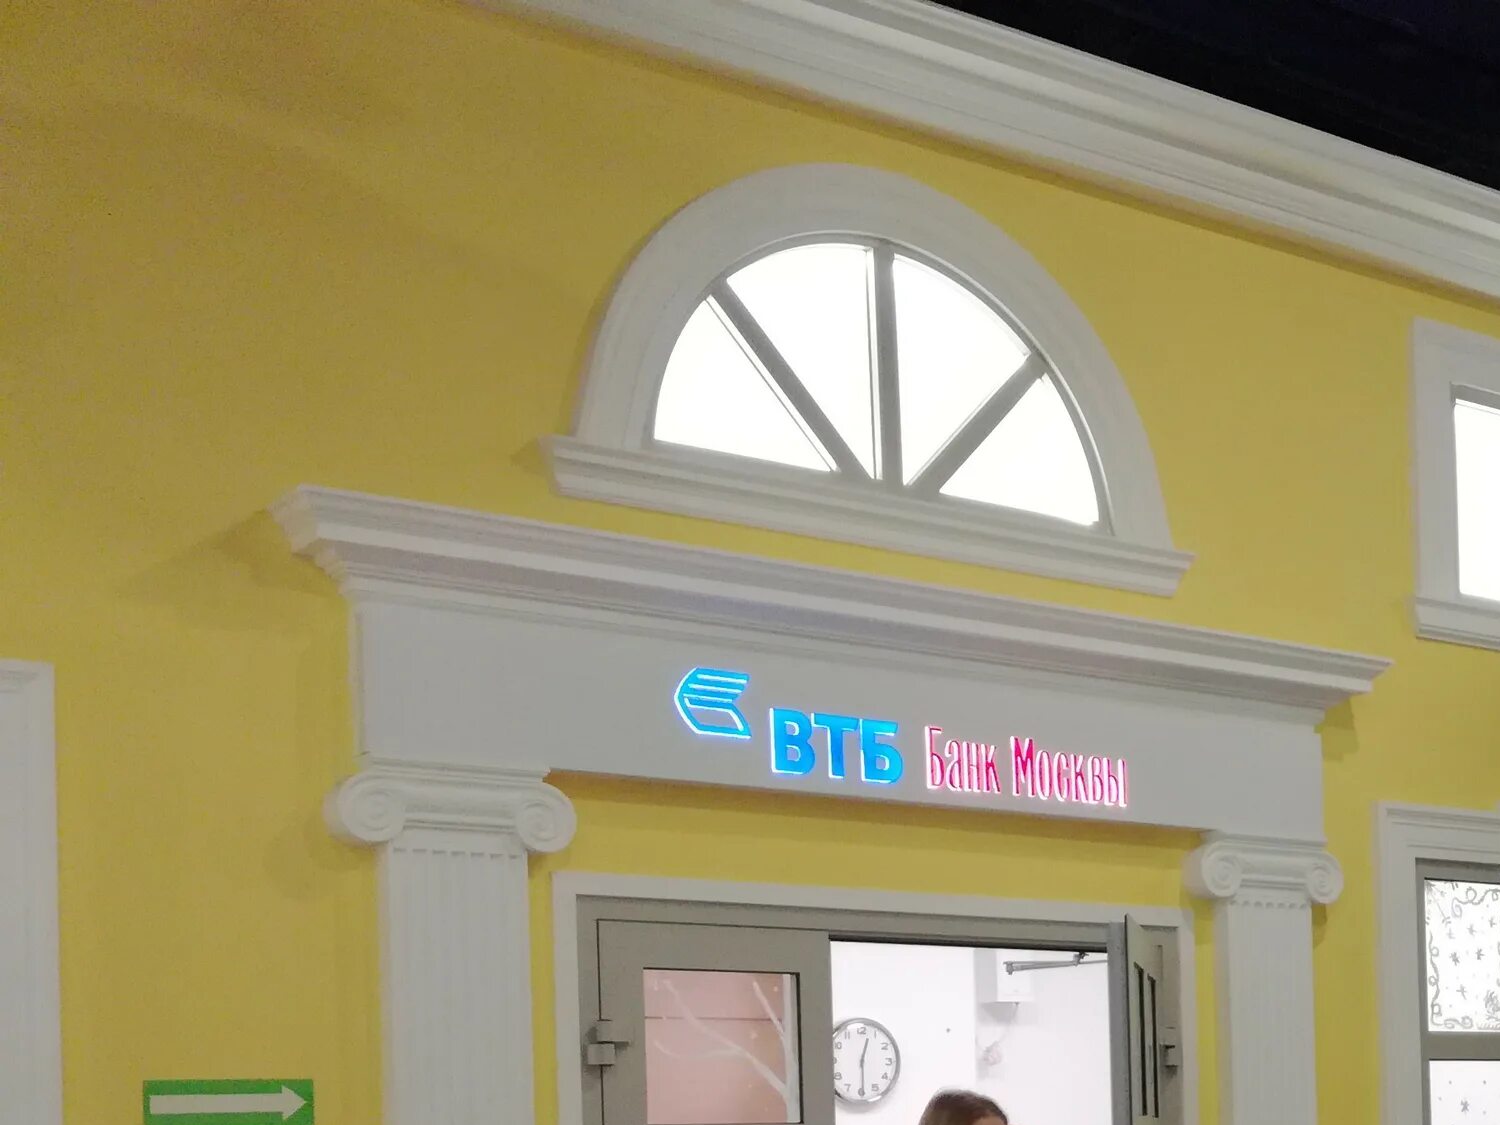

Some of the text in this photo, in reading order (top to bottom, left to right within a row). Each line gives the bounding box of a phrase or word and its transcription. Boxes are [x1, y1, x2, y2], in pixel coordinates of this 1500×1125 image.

[769, 707, 1129, 808] ВТБ Банк Москвы
[857, 1026, 867, 1035] 12
